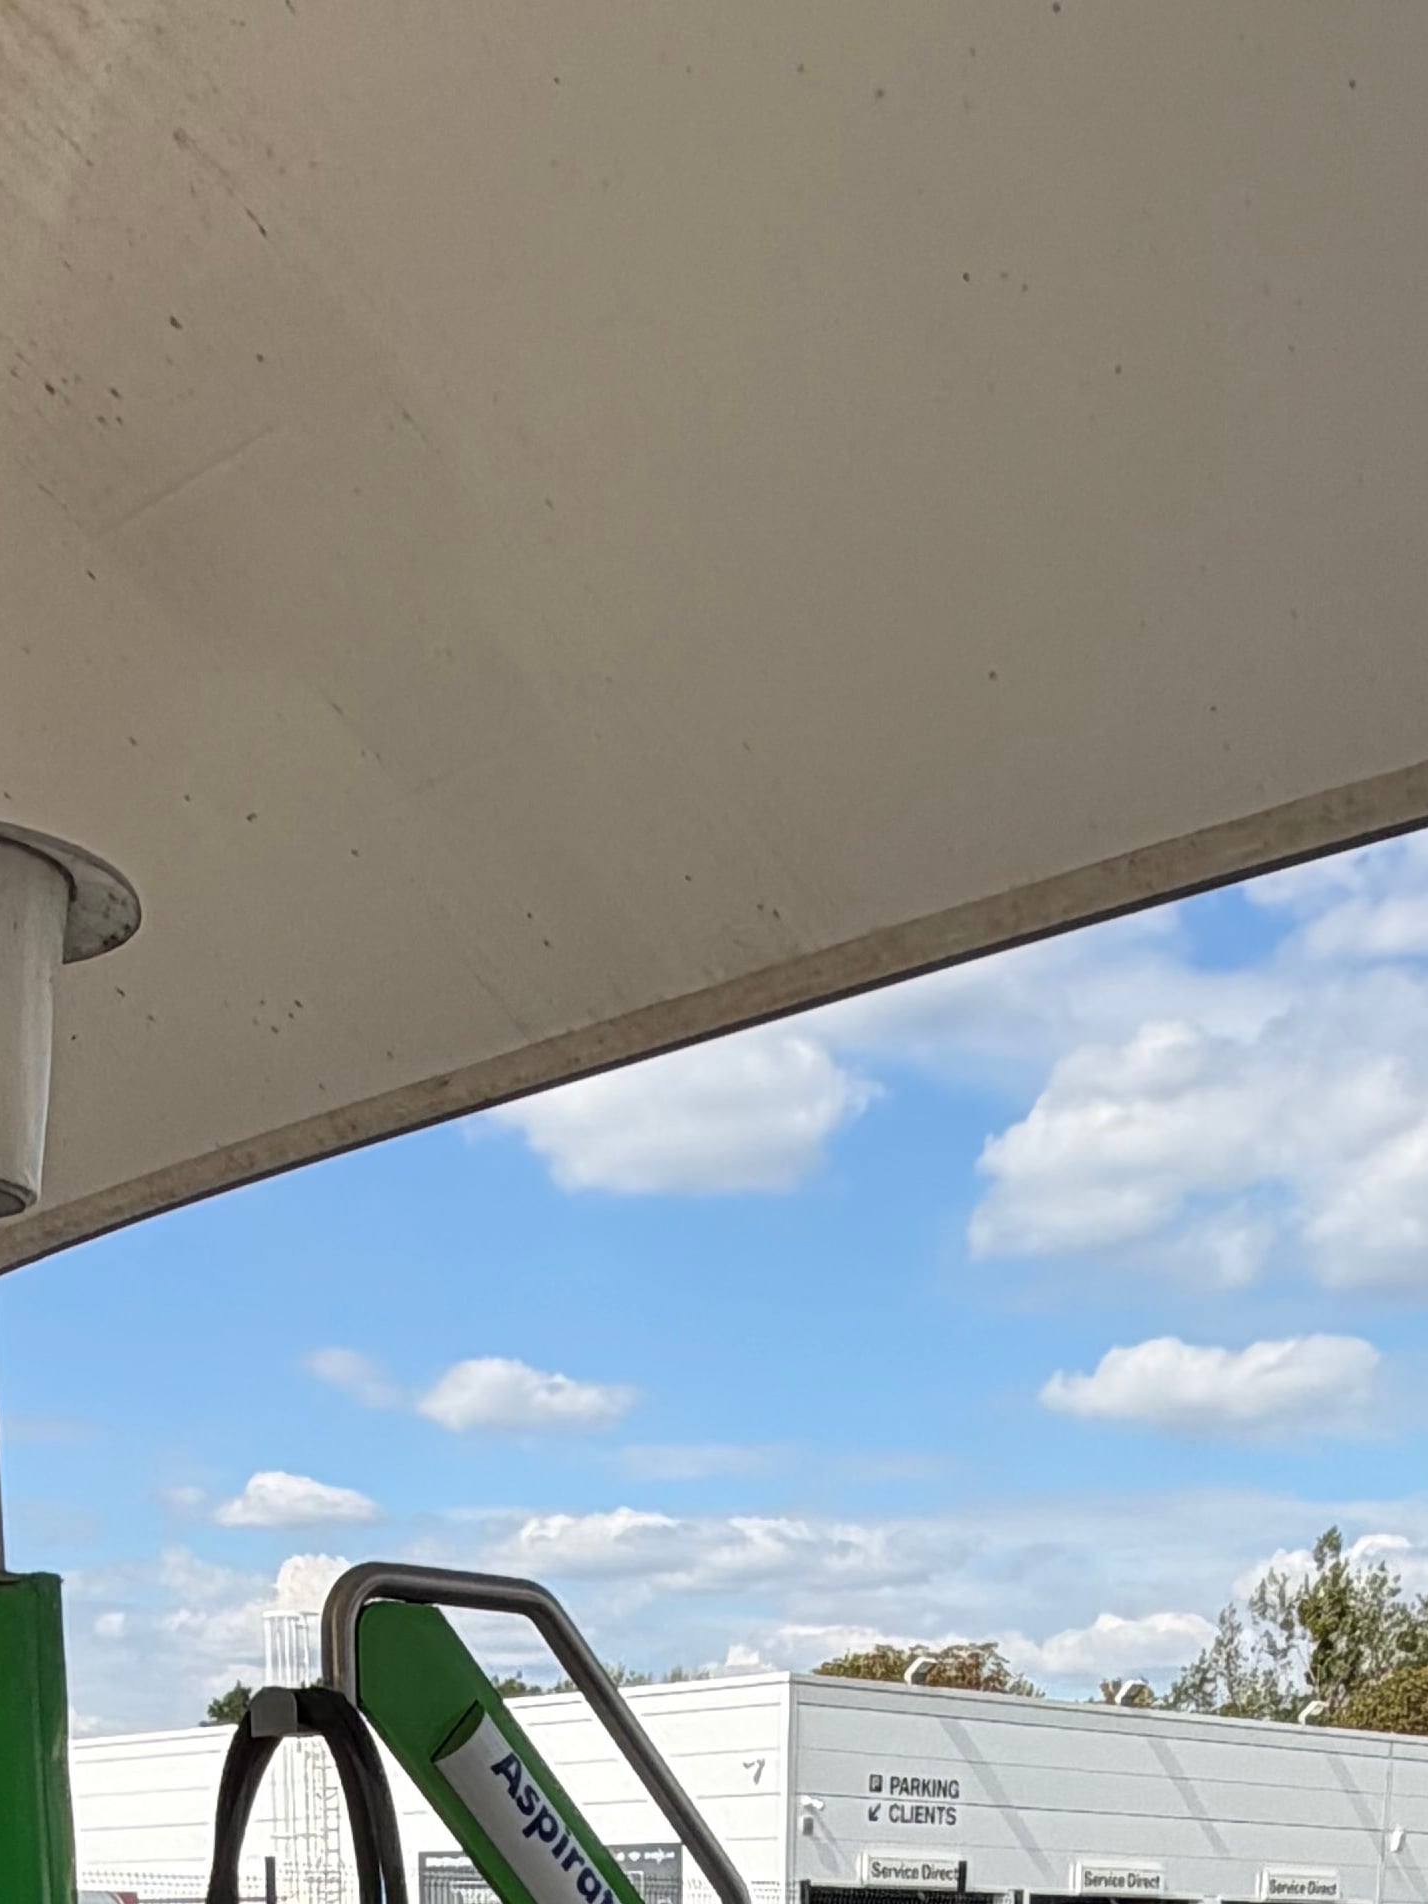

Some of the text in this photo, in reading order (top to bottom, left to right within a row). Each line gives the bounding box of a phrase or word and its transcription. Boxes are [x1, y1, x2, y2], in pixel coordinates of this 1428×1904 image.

[889, 1776, 960, 1799] PARKING
[889, 1803, 957, 1826] CLIENTS
[872, 1861, 919, 1880] Service
[1084, 1871, 1160, 1890] Service Direct
[1269, 1879, 1306, 1895] Service
